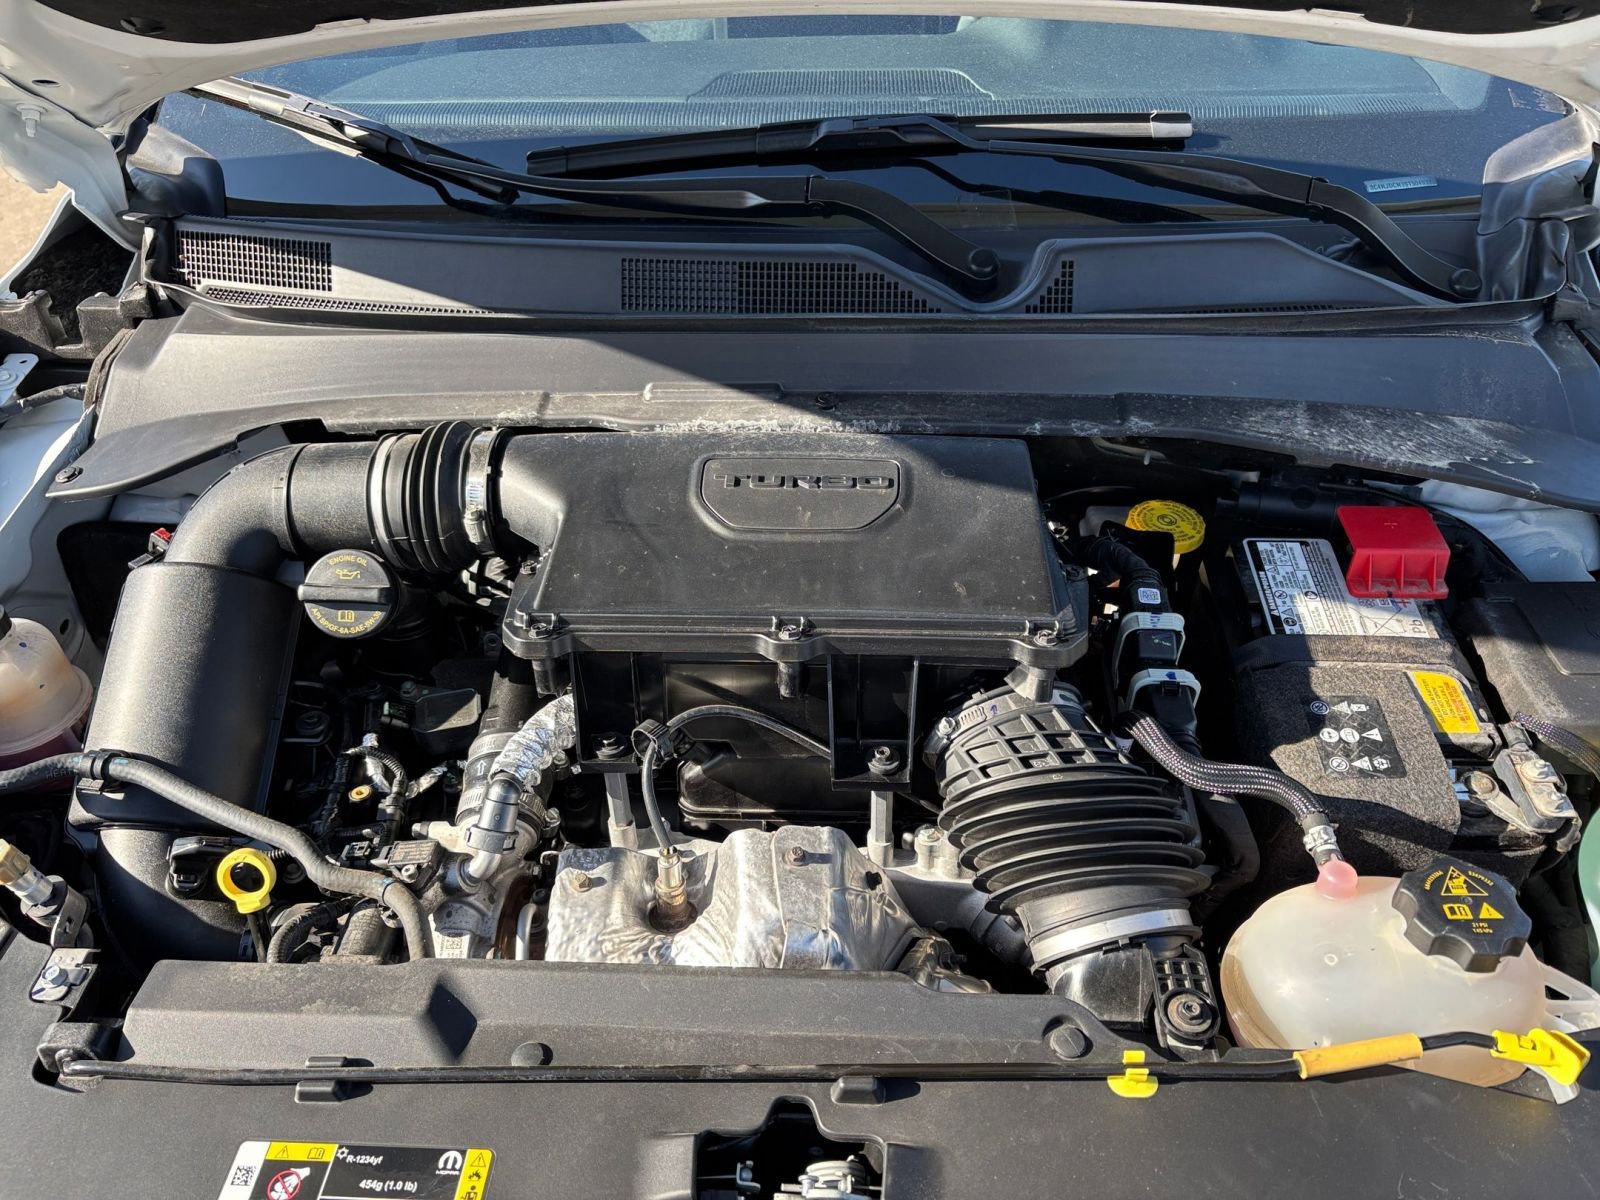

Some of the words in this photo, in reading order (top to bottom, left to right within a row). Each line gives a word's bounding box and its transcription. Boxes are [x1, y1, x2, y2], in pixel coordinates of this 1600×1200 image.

[713, 474, 895, 489] TURBO
[328, 555, 357, 566] ENGINE
[357, 556, 368, 567] OIL
[311, 608, 321, 620] API
[1409, 619, 1426, 634] Pb
[346, 1155, 383, 1166] R-1234yf
[359, 1179, 383, 1192] 454g
[384, 1180, 404, 1192] (1.0
[404, 1181, 418, 1193] lb)
